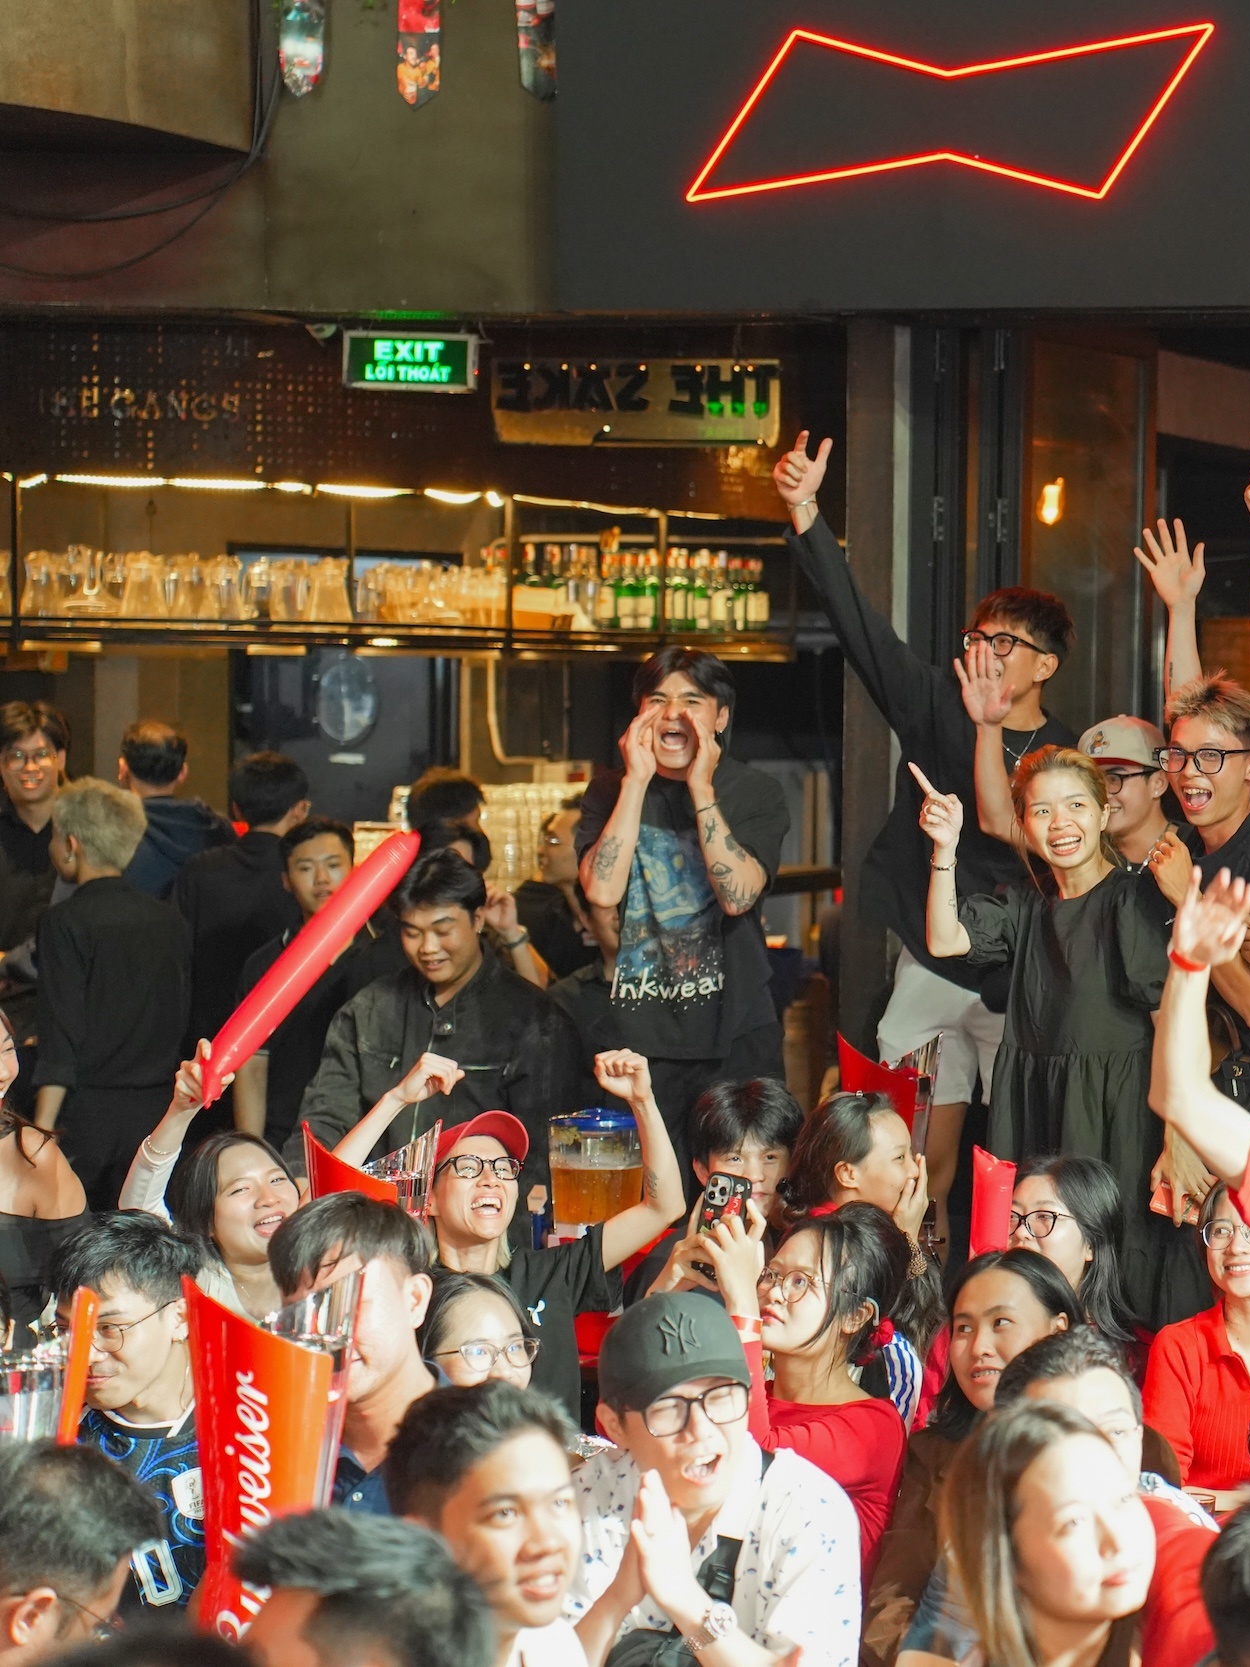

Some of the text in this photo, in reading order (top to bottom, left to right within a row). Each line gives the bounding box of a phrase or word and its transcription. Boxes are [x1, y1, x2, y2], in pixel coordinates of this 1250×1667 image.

[374, 340, 444, 362] EXIT
[397, 362, 452, 382] THOÁT
[610, 967, 725, 1000] Inkwear
[656, 1311, 701, 1356] NY
[215, 1370, 272, 1645] Buweiser
